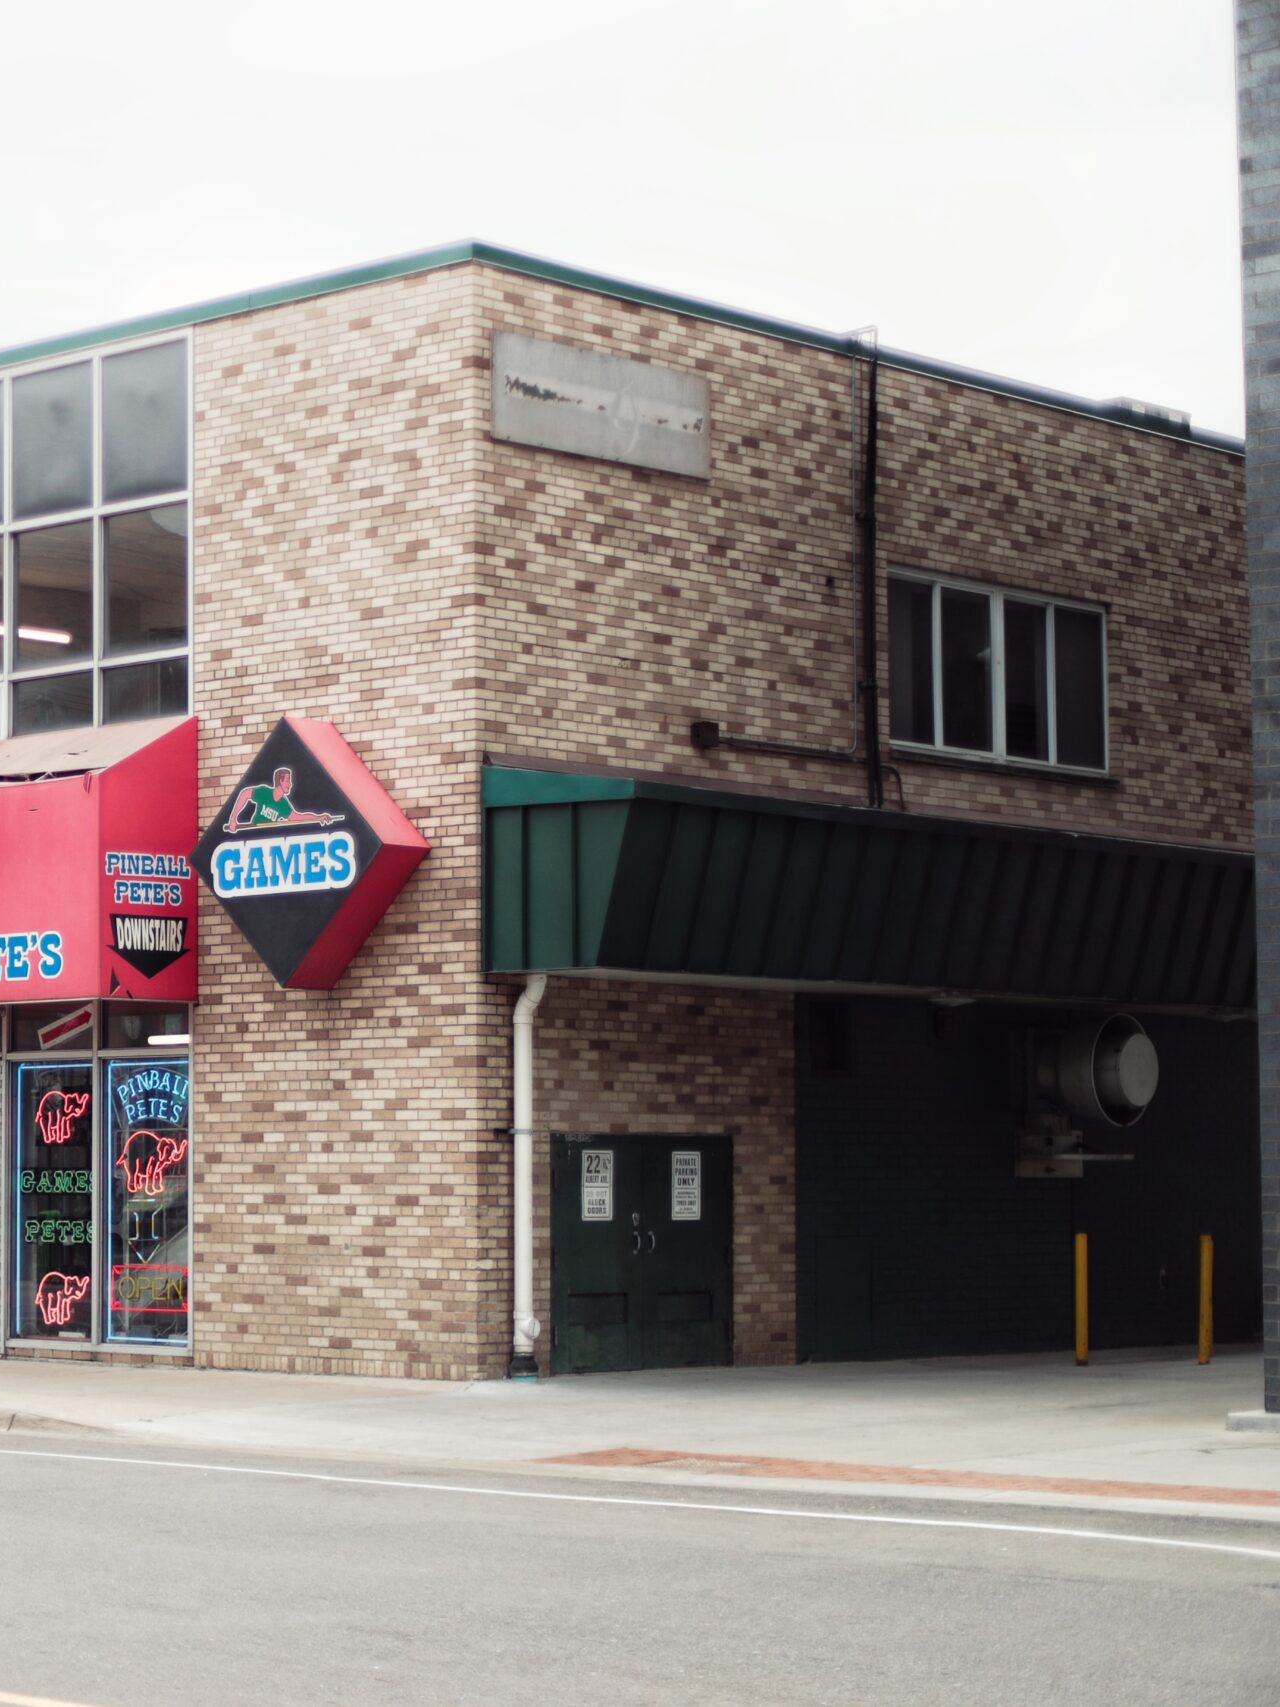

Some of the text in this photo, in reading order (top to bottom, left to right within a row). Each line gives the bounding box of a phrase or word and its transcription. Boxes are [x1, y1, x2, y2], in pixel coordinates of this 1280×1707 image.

[261, 804, 279, 822] MSU
[105, 851, 191, 880] PINBALL
[214, 836, 354, 893] GAMES
[114, 880, 182, 906] PETE'S
[116, 917, 183, 952] DOWNSTAIRS
[117, 1069, 189, 1104] PINBALL
[125, 1098, 182, 1125] PETE'S
[675, 1158, 697, 1167] PRIVATE
[675, 1167, 698, 1177] PARKING
[677, 1177, 696, 1186] ONLY
[118, 1276, 183, 1300] OPEN
